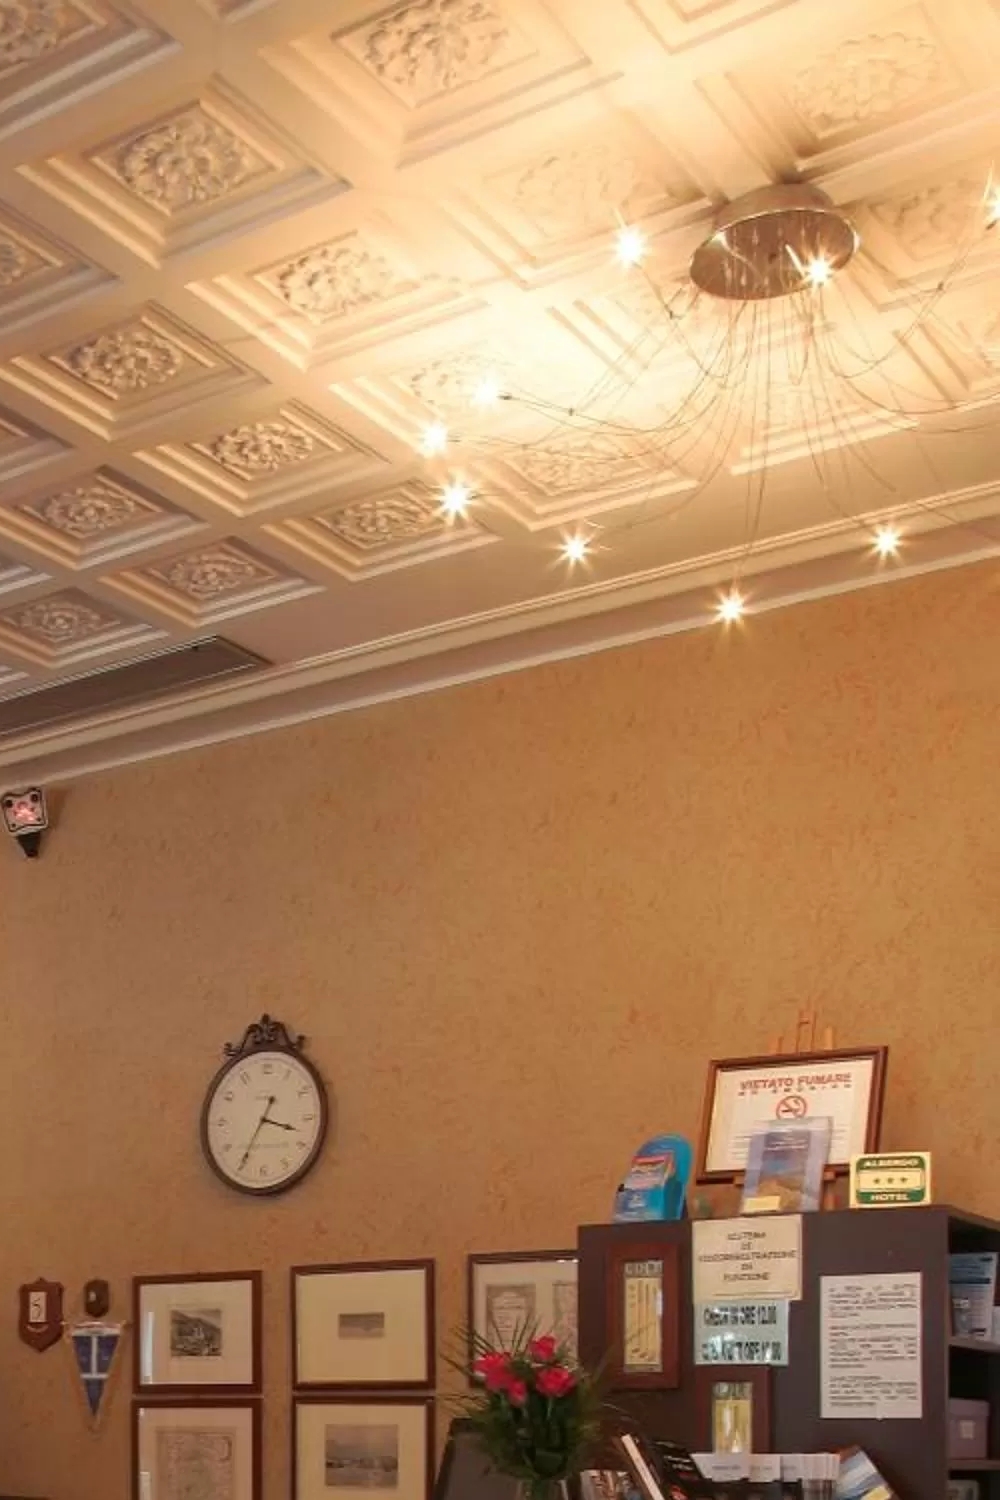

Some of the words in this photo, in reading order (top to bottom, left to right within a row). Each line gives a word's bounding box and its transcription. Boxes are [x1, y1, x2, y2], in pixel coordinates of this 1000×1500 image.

[741, 1078, 793, 1090] VIETATO
[798, 1072, 852, 1085] FUMARE
[863, 1158, 919, 1168] ALBERGO
[871, 1193, 911, 1201] HOTEL
